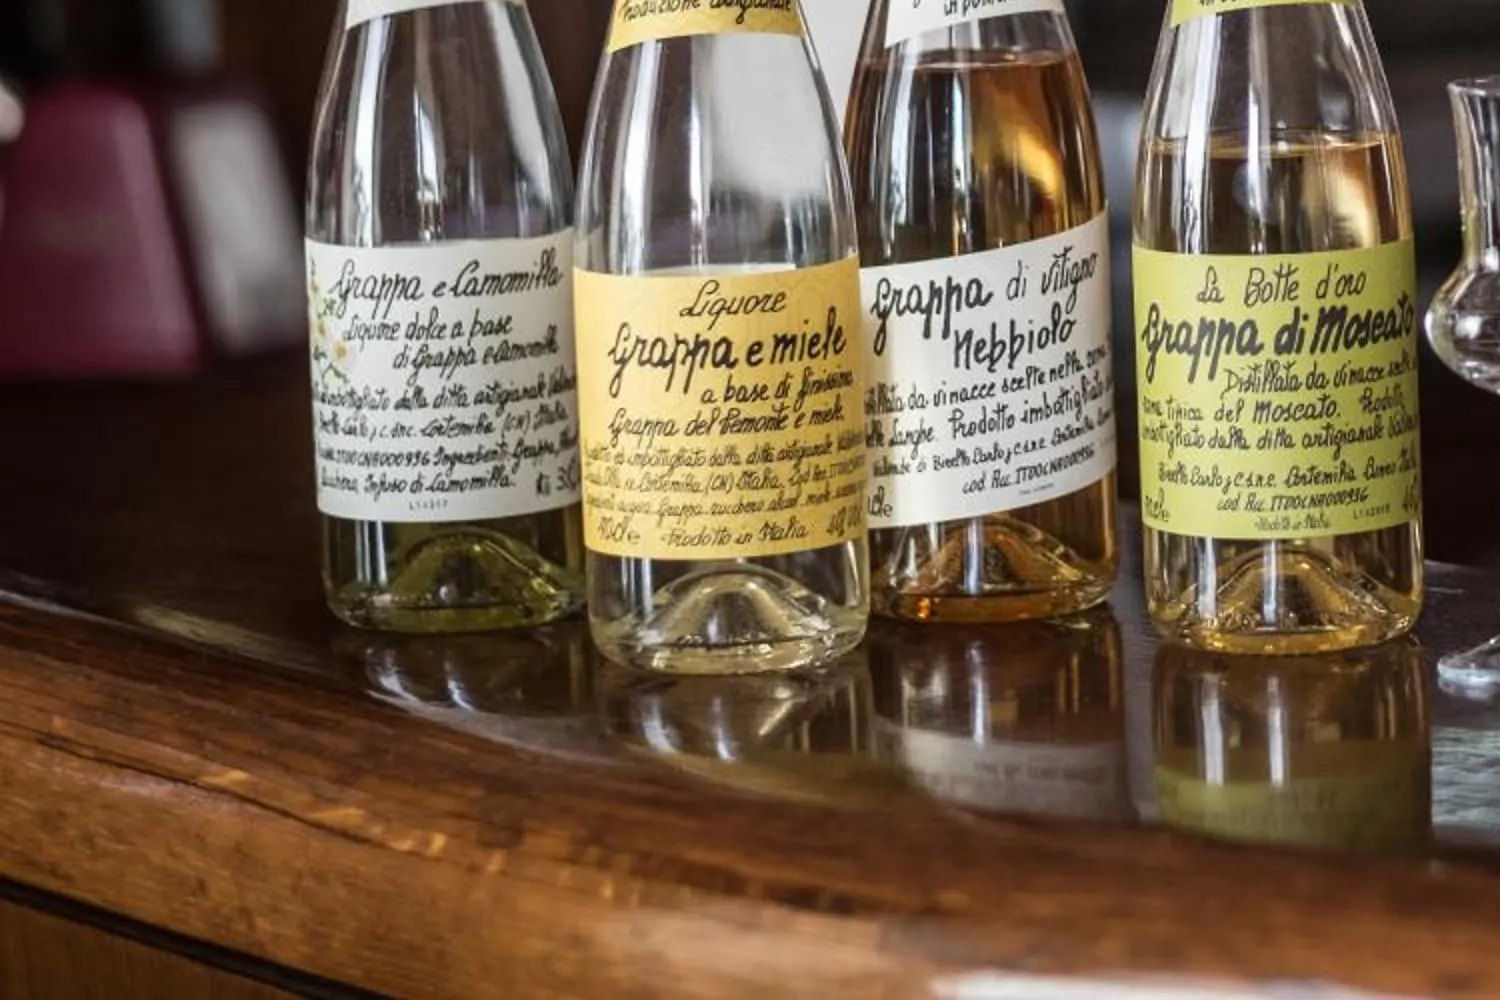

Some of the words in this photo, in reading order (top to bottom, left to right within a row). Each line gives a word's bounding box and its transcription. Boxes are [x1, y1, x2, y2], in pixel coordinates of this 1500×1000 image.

[328, 257, 425, 321] Grappa
[449, 246, 565, 298] Camomilla
[679, 279, 787, 331] Liquore
[1196, 265, 1225, 303] La
[1243, 263, 1299, 308] Botte
[466, 307, 513, 346] base
[869, 275, 995, 358] Grappa
[1005, 257, 1030, 302] di
[606, 321, 739, 400] Grappa
[745, 339, 764, 368] e
[768, 305, 848, 365] miele
[1140, 301, 1266, 385] Grappa
[1273, 305, 1310, 356] di
[1309, 290, 1415, 356] Moscato
[701, 388, 719, 404] a
[723, 373, 770, 404] base
[774, 371, 794, 400] di
[932, 380, 997, 408] vinacce
[1220, 358, 1303, 399] Distillata
[607, 406, 681, 449] Grappa
[947, 400, 1016, 441] Prodotto
[1213, 397, 1246, 423] del
